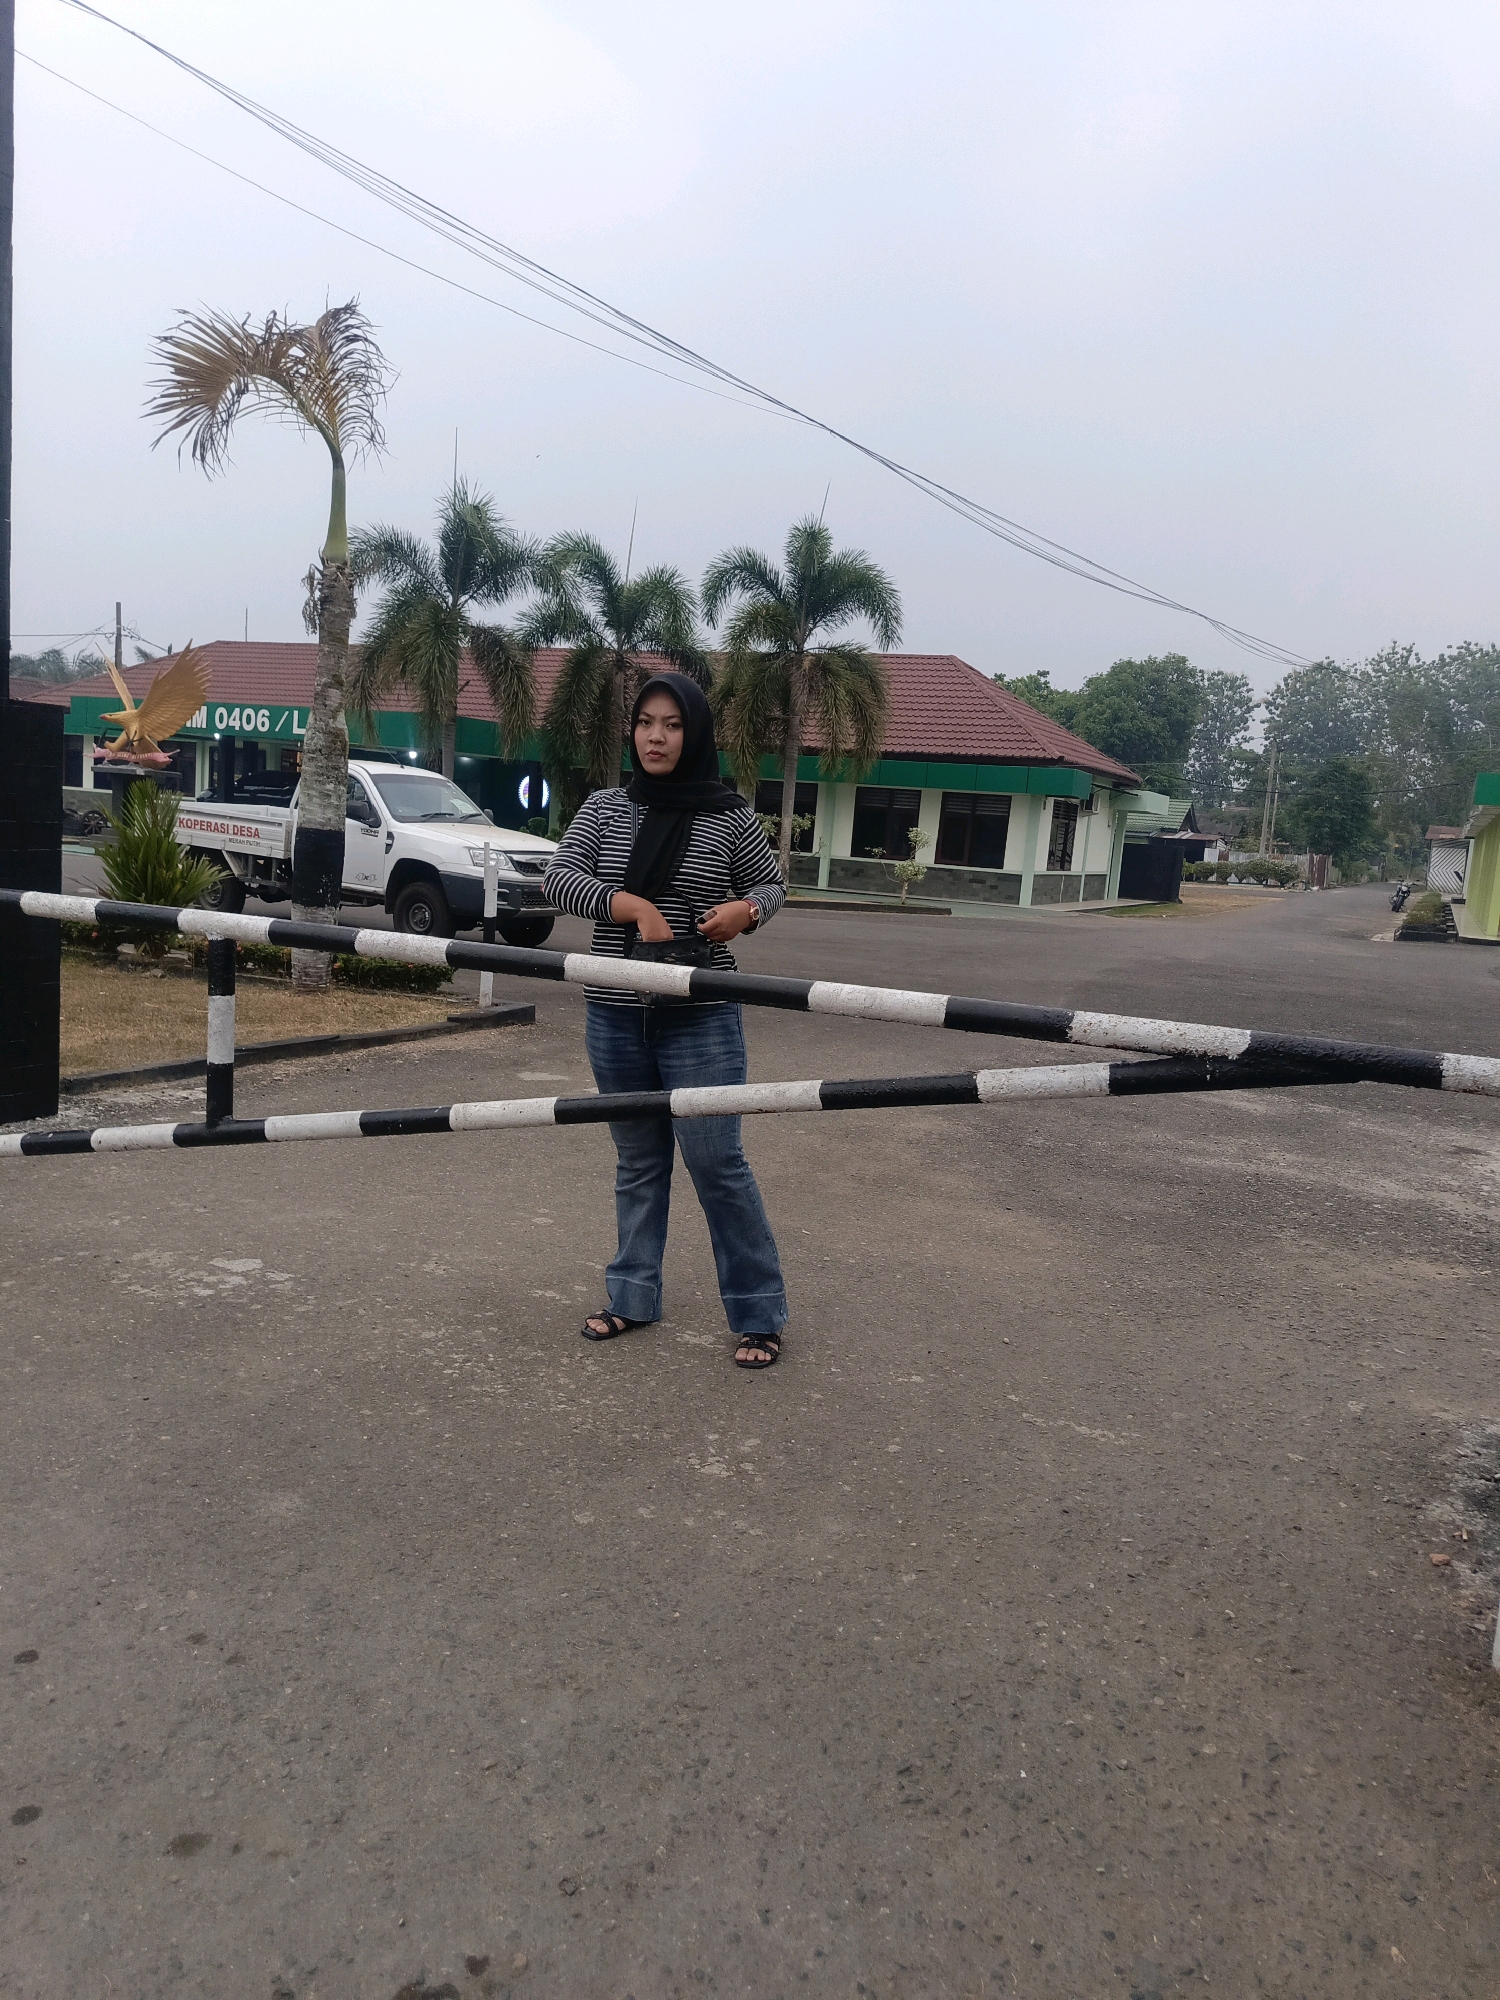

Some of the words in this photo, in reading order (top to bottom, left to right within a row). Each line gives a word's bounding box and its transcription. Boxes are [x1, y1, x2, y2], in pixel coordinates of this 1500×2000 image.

[178, 817, 230, 834] KOPERASI
[232, 824, 261, 839] DESA
[228, 837, 246, 845] MERAH
